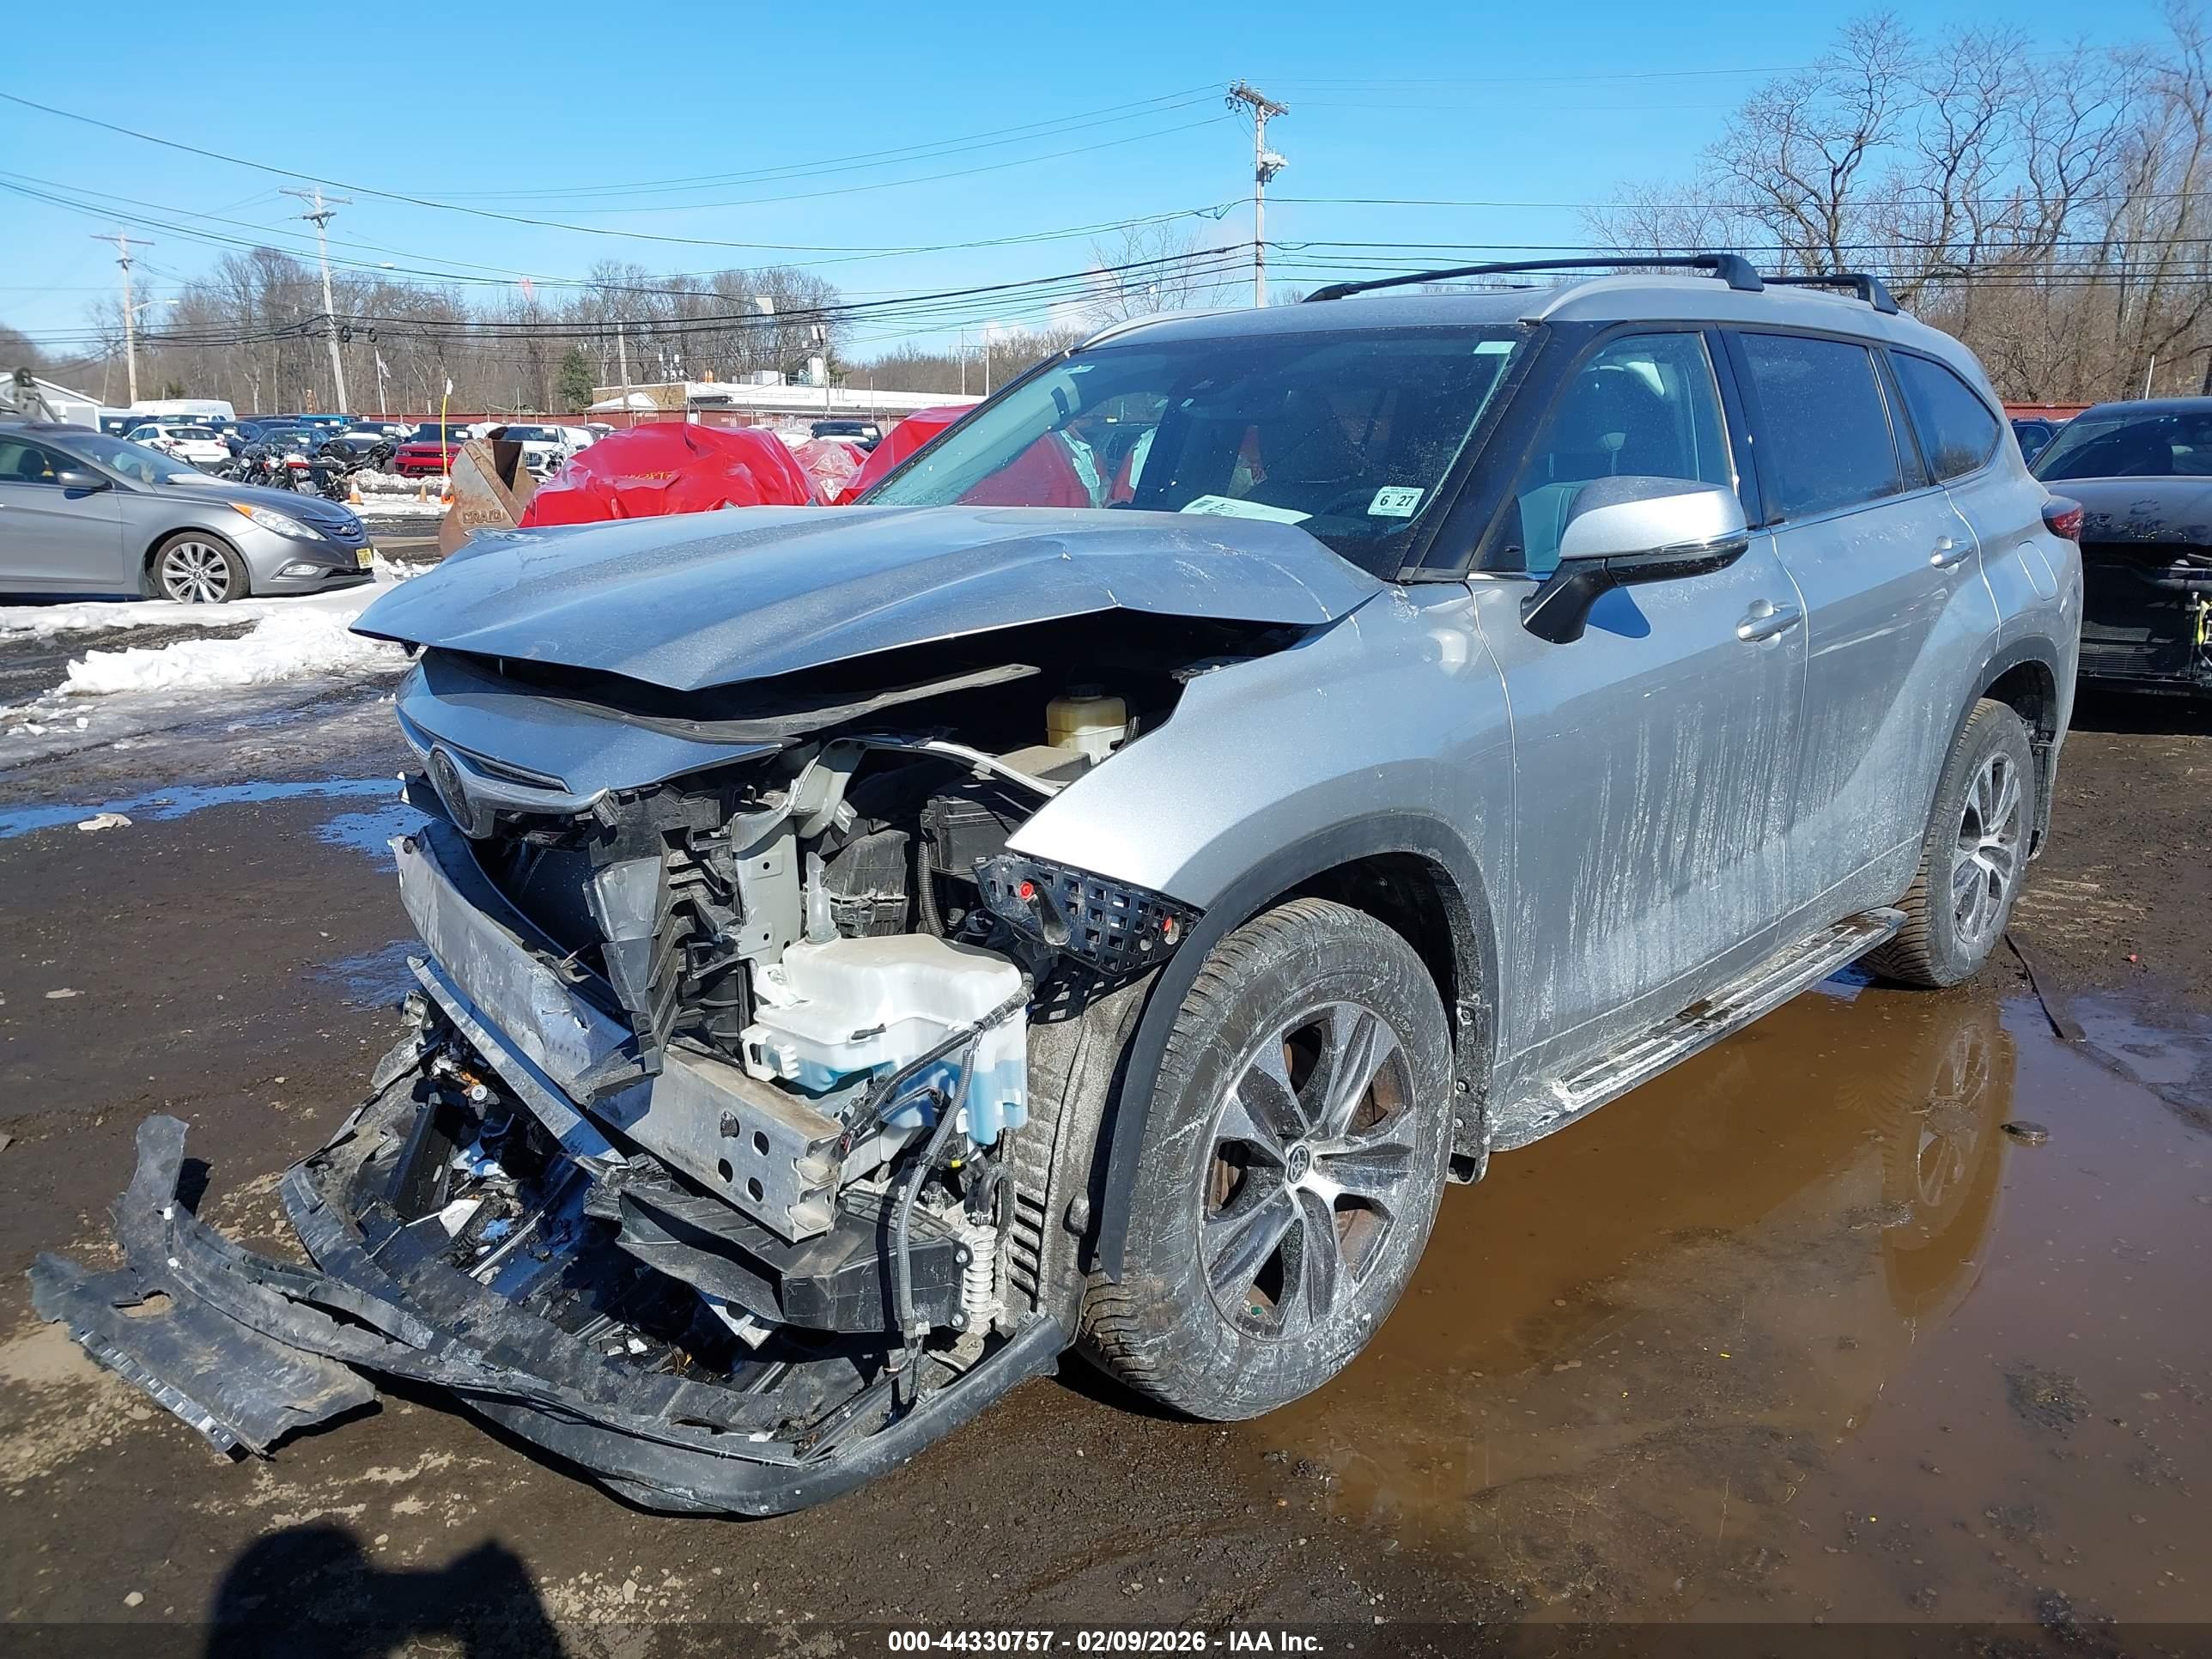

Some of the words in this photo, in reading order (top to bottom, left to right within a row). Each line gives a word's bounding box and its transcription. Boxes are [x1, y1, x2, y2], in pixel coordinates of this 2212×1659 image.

[1379, 495, 1390, 506] 6
[1395, 495, 1415, 507] 27
[463, 508, 502, 523] CRAIG
